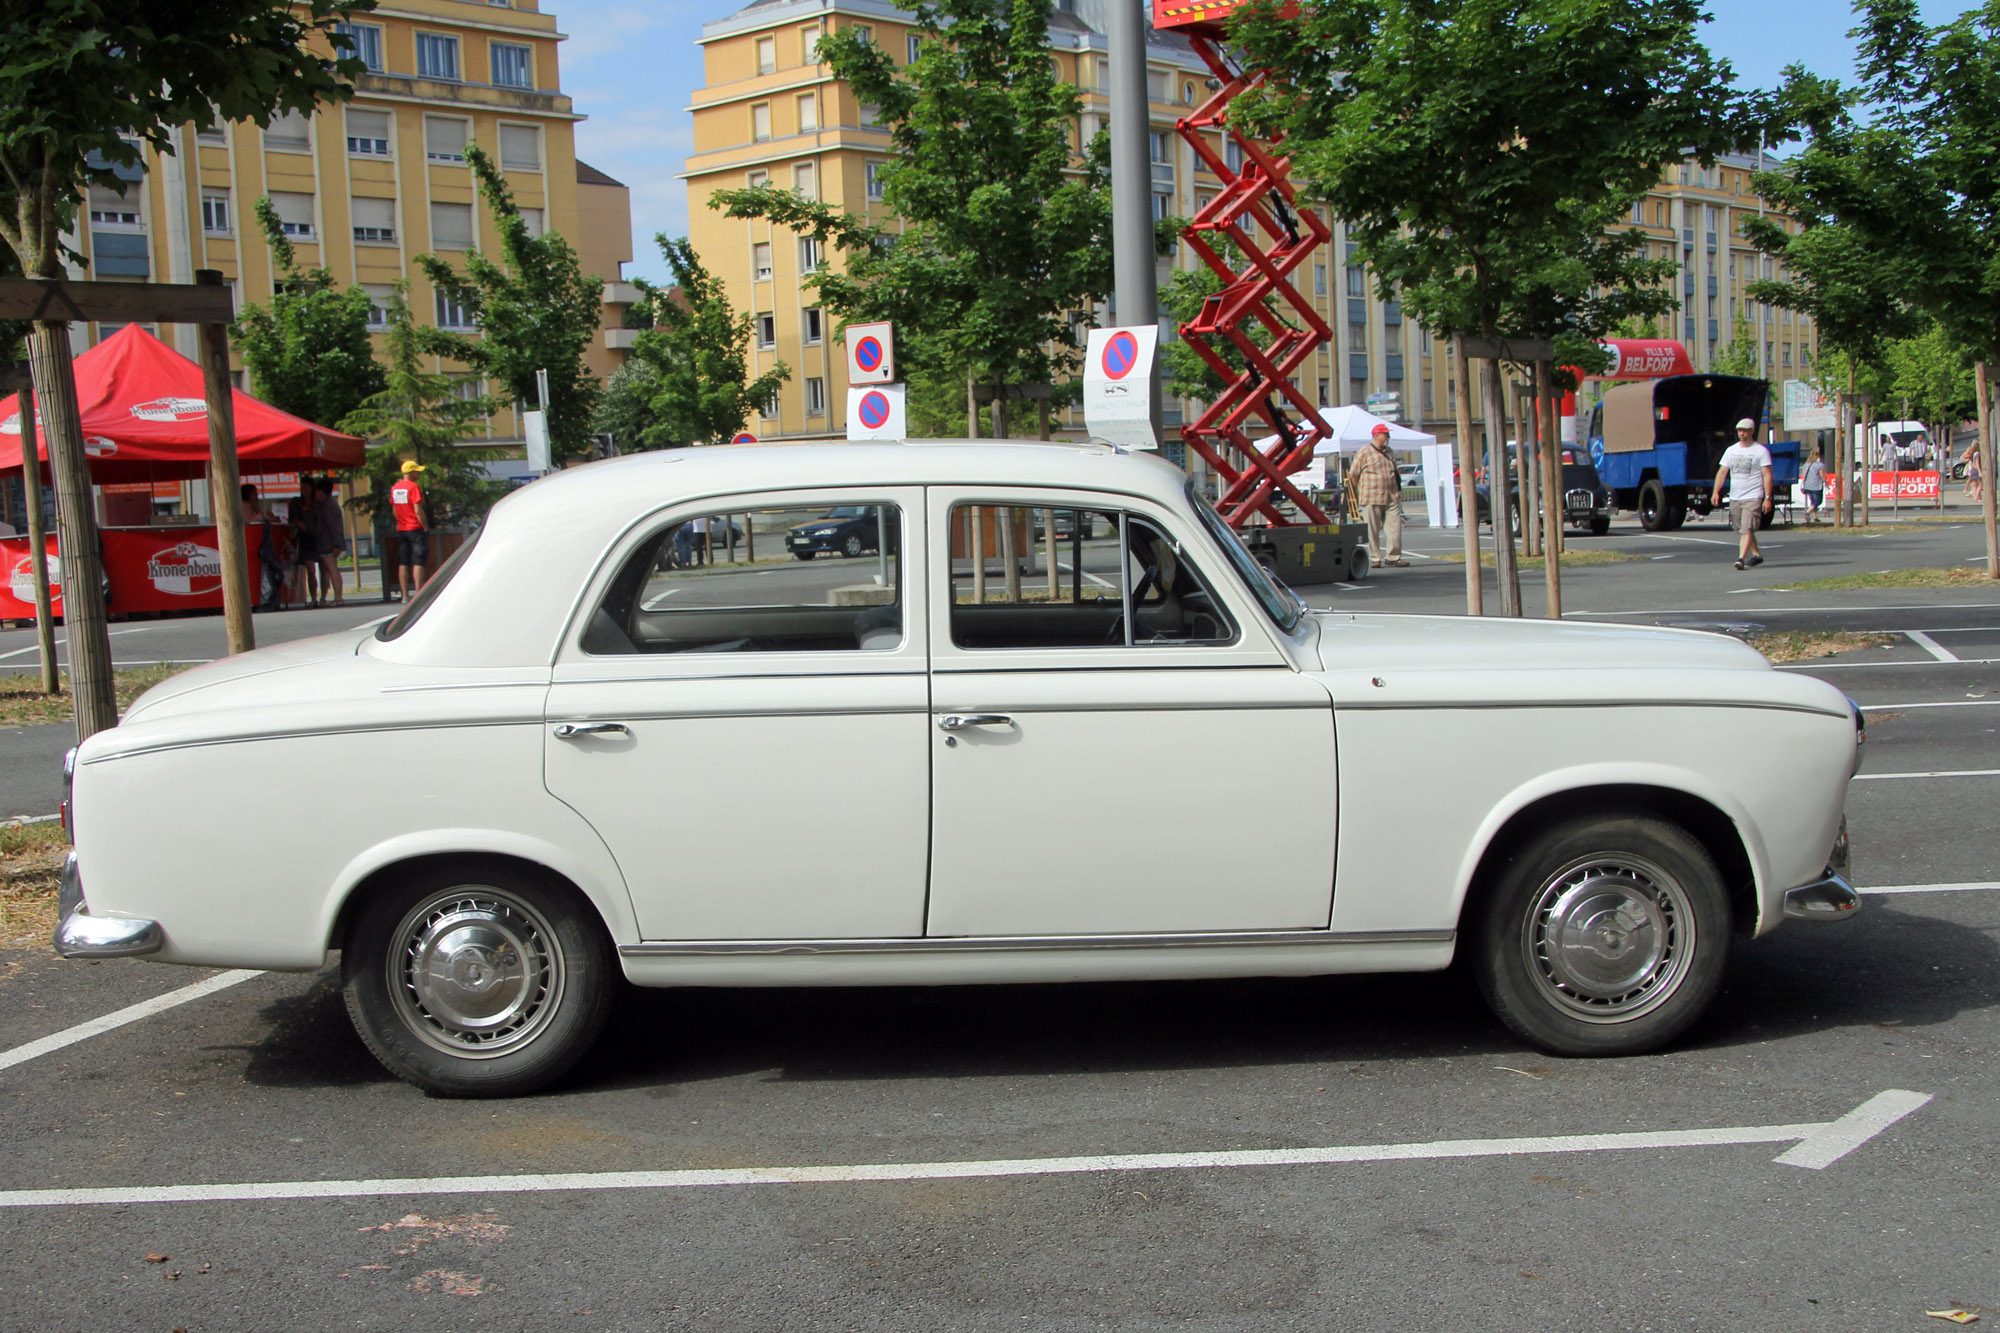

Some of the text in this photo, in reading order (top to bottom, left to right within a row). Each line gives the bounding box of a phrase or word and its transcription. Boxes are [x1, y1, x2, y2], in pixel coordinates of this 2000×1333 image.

[1644, 347, 1675, 356] VILLE DE
[1624, 357, 1675, 372] BELFORT
[131, 404, 208, 416] Kronenbour
[1925, 476, 1936, 484] DE
[1872, 483, 1936, 494] BELFORT
[148, 559, 222, 578] Kronenbour
